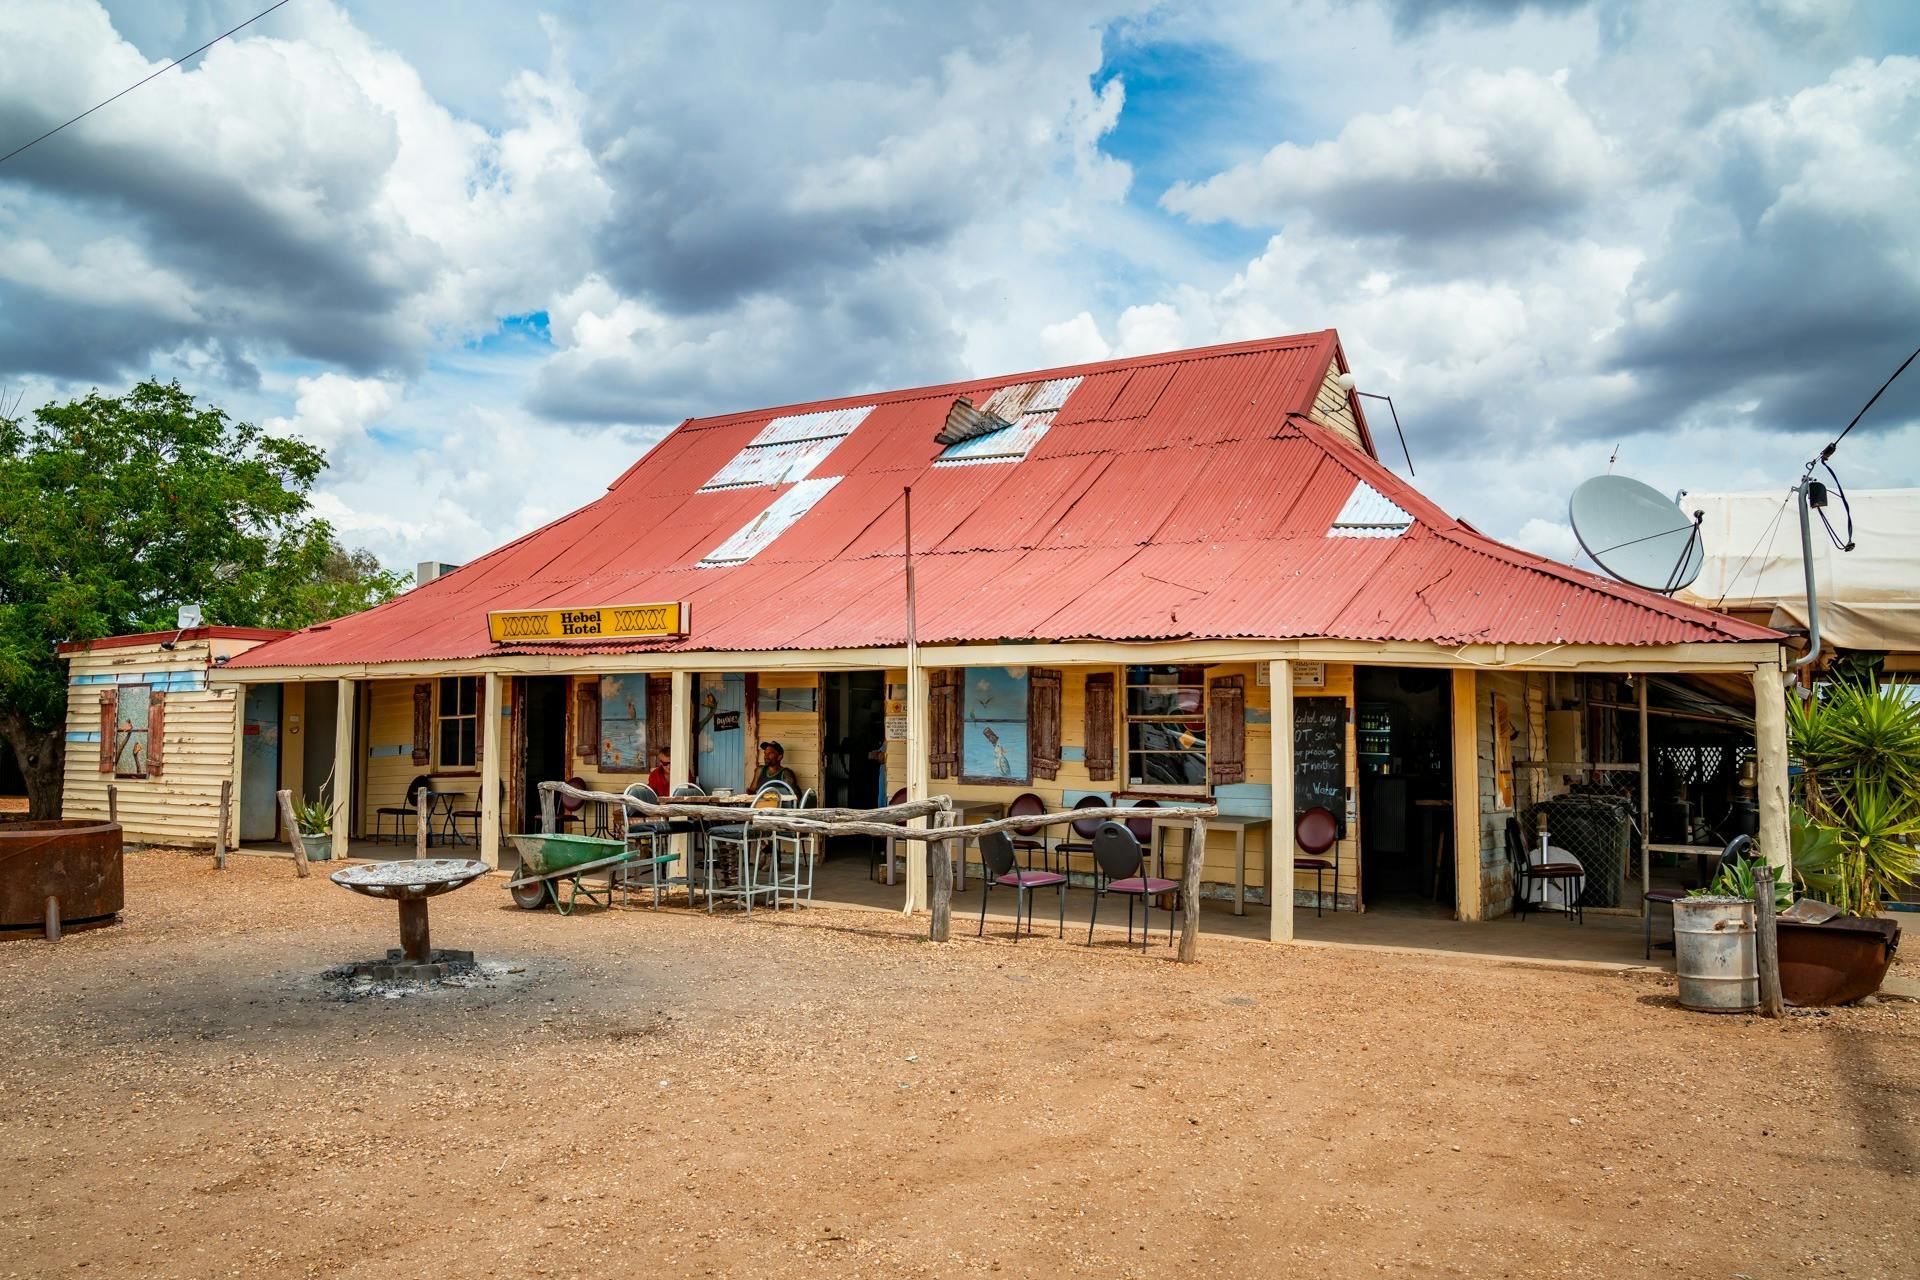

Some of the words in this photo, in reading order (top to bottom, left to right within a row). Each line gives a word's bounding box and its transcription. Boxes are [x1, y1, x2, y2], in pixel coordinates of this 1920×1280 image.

[560, 611, 602, 624] Hebel
[614, 608, 667, 632] XXXX
[502, 615, 550, 637] XXXX
[562, 623, 602, 635] Hotel
[1294, 729, 1312, 743] OT
